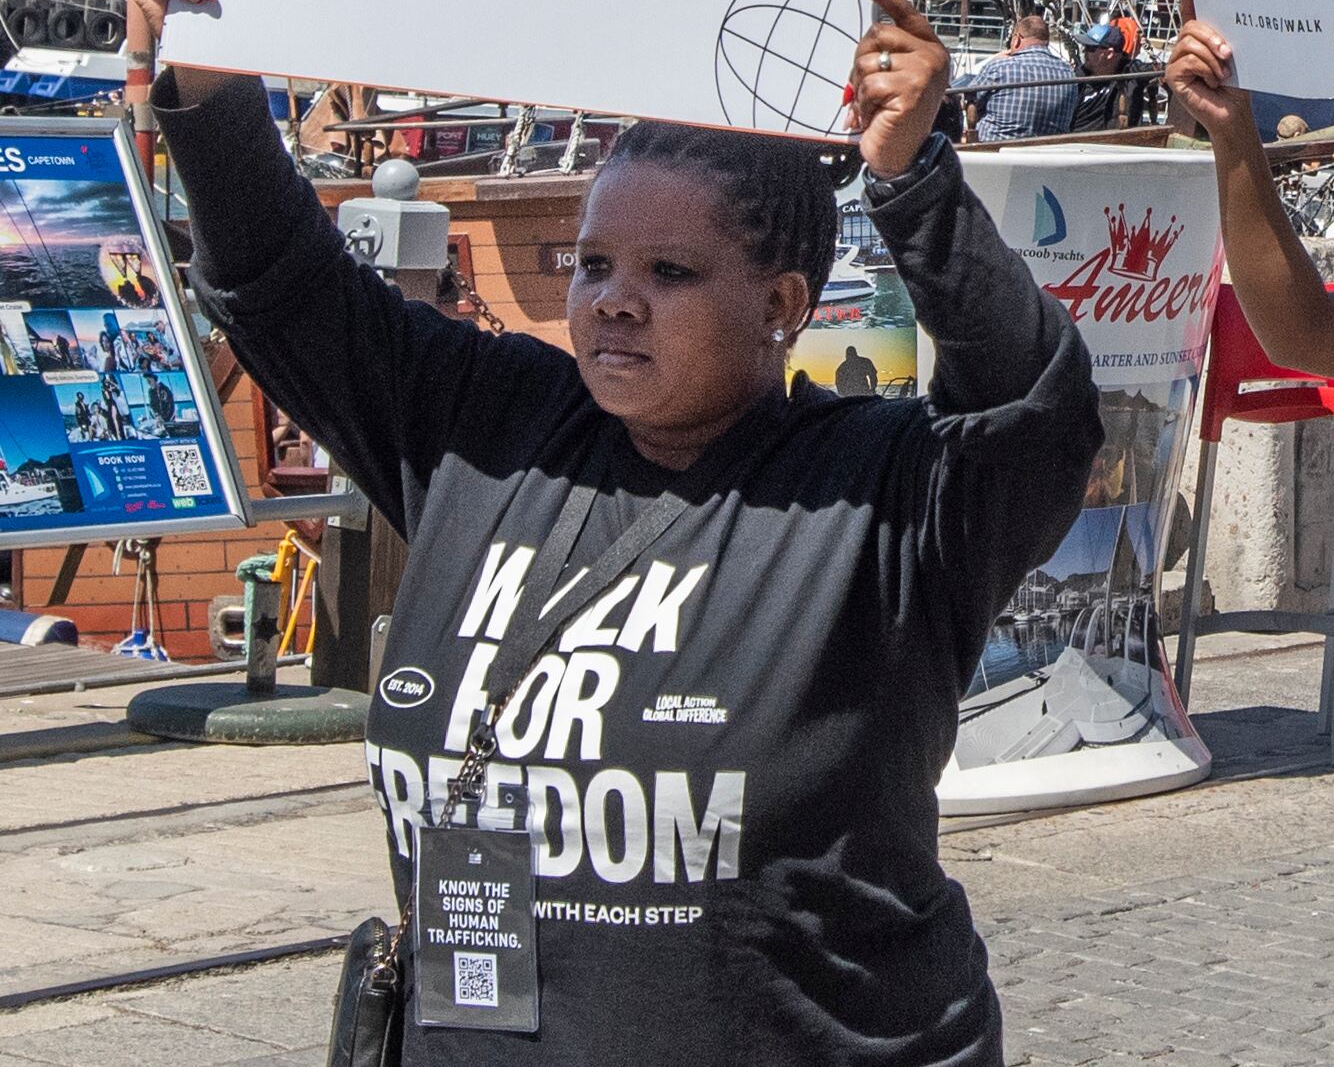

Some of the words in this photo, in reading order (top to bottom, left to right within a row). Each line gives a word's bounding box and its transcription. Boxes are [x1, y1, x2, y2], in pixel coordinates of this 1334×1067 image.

[1235, 12, 1322, 33] A21.ORG/WALK
[556, 252, 577, 270] JO
[1052, 248, 1085, 262] yachts
[1133, 352, 1158, 366] AND
[98, 456, 122, 466] BOOK
[125, 455, 145, 464] NOW
[402, 680, 424, 696] 2014
[444, 643, 620, 761] FOR
[656, 695, 682, 710] LOCAL
[684, 696, 717, 708] ACTION
[642, 708, 675, 721] GLOBAL
[676, 708, 728, 723] DIFFERENCE
[366, 741, 747, 886] FREEDOM
[439, 880, 480, 898] KNOW
[483, 881, 510, 899] THE
[442, 896, 484, 913] SIGNS
[487, 899, 505, 914] OF
[531, 901, 581, 922] WITH
[585, 904, 640, 926] EACH
[644, 905, 703, 926] STEP
[449, 914, 499, 931] HUMAN
[427, 928, 522, 949] TRAFFICKING.
